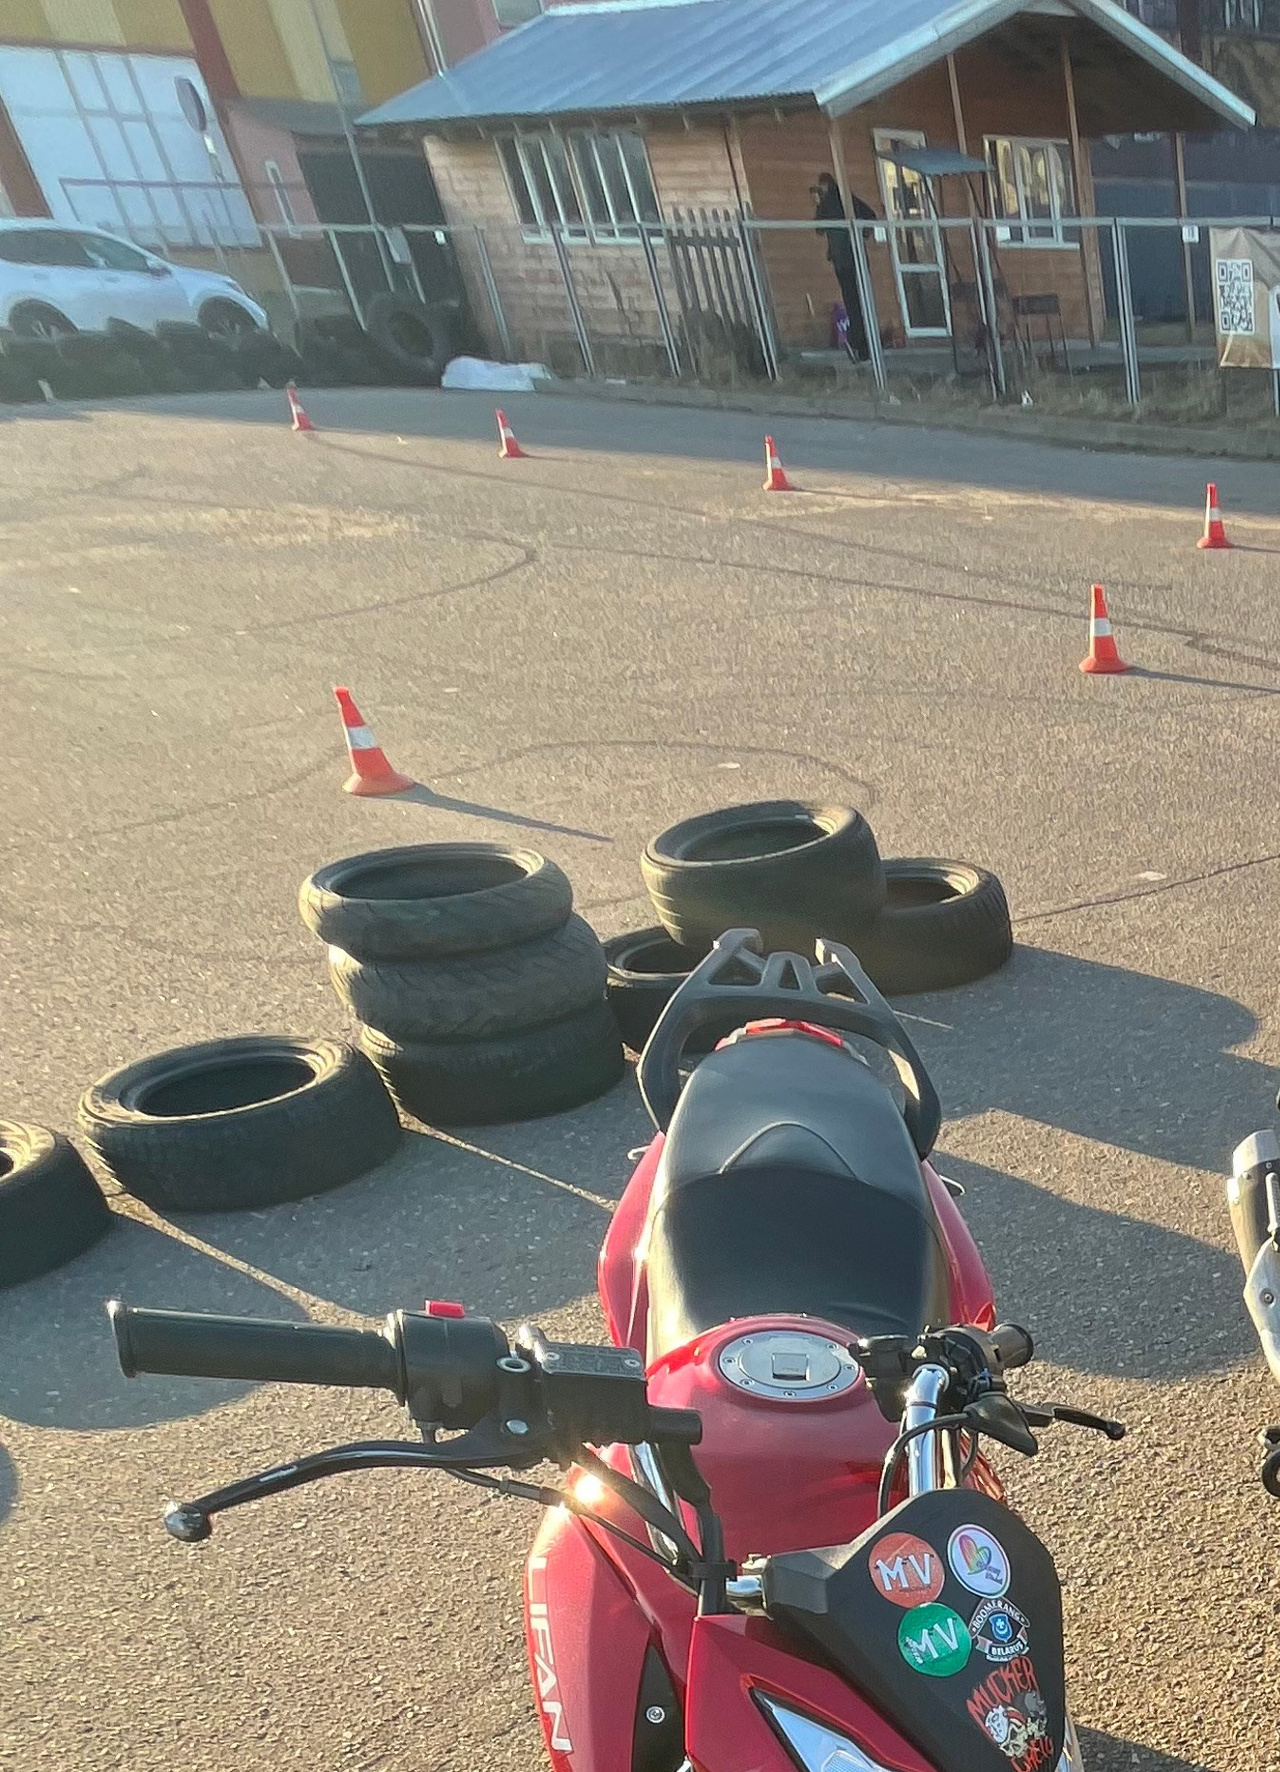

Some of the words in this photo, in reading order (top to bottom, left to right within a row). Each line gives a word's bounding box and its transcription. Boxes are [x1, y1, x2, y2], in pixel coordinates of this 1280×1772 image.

[874, 1552, 932, 1592] MV
[971, 1598, 1023, 1631] BOOMERANG
[527, 1556, 574, 1755] LIFAN
[905, 1617, 959, 1664] MV
[991, 1641, 1025, 1656] BELARUS
